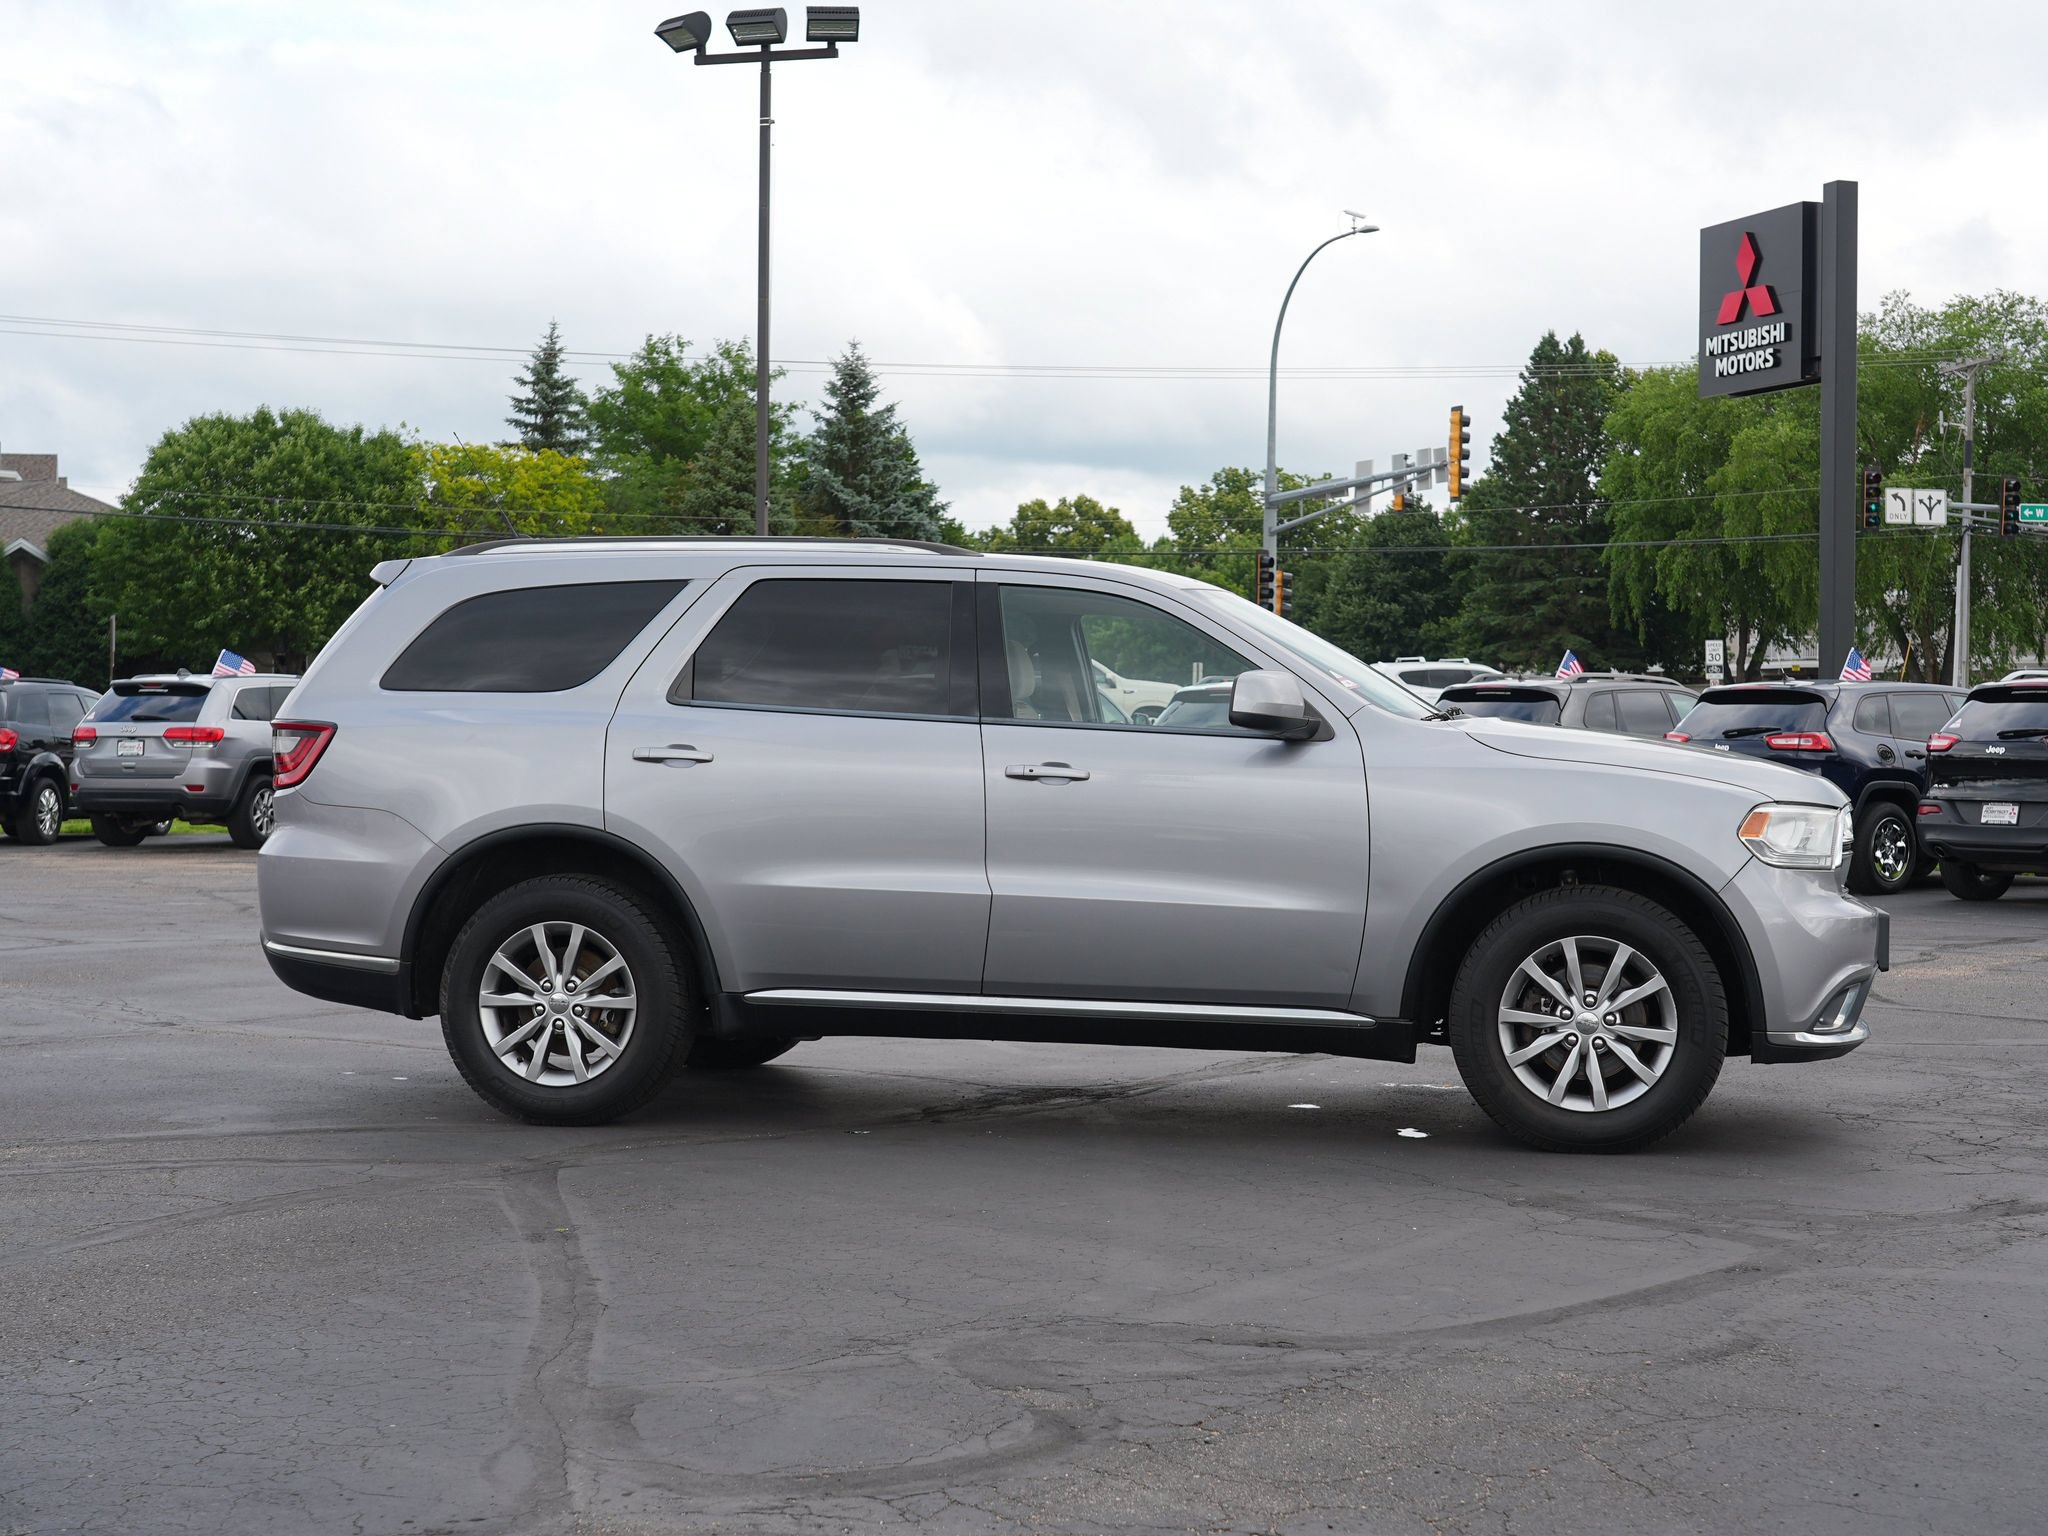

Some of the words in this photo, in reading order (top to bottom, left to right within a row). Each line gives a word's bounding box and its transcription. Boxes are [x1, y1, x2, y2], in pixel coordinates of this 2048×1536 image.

[1705, 322, 1785, 357] MITSUBISHI
[1715, 348, 1774, 377] MOTORS
[1889, 512, 1907, 520] ONLY
[2036, 508, 2044, 518] W
[1708, 653, 1721, 661] 30
[1985, 745, 2006, 754] Jeep
